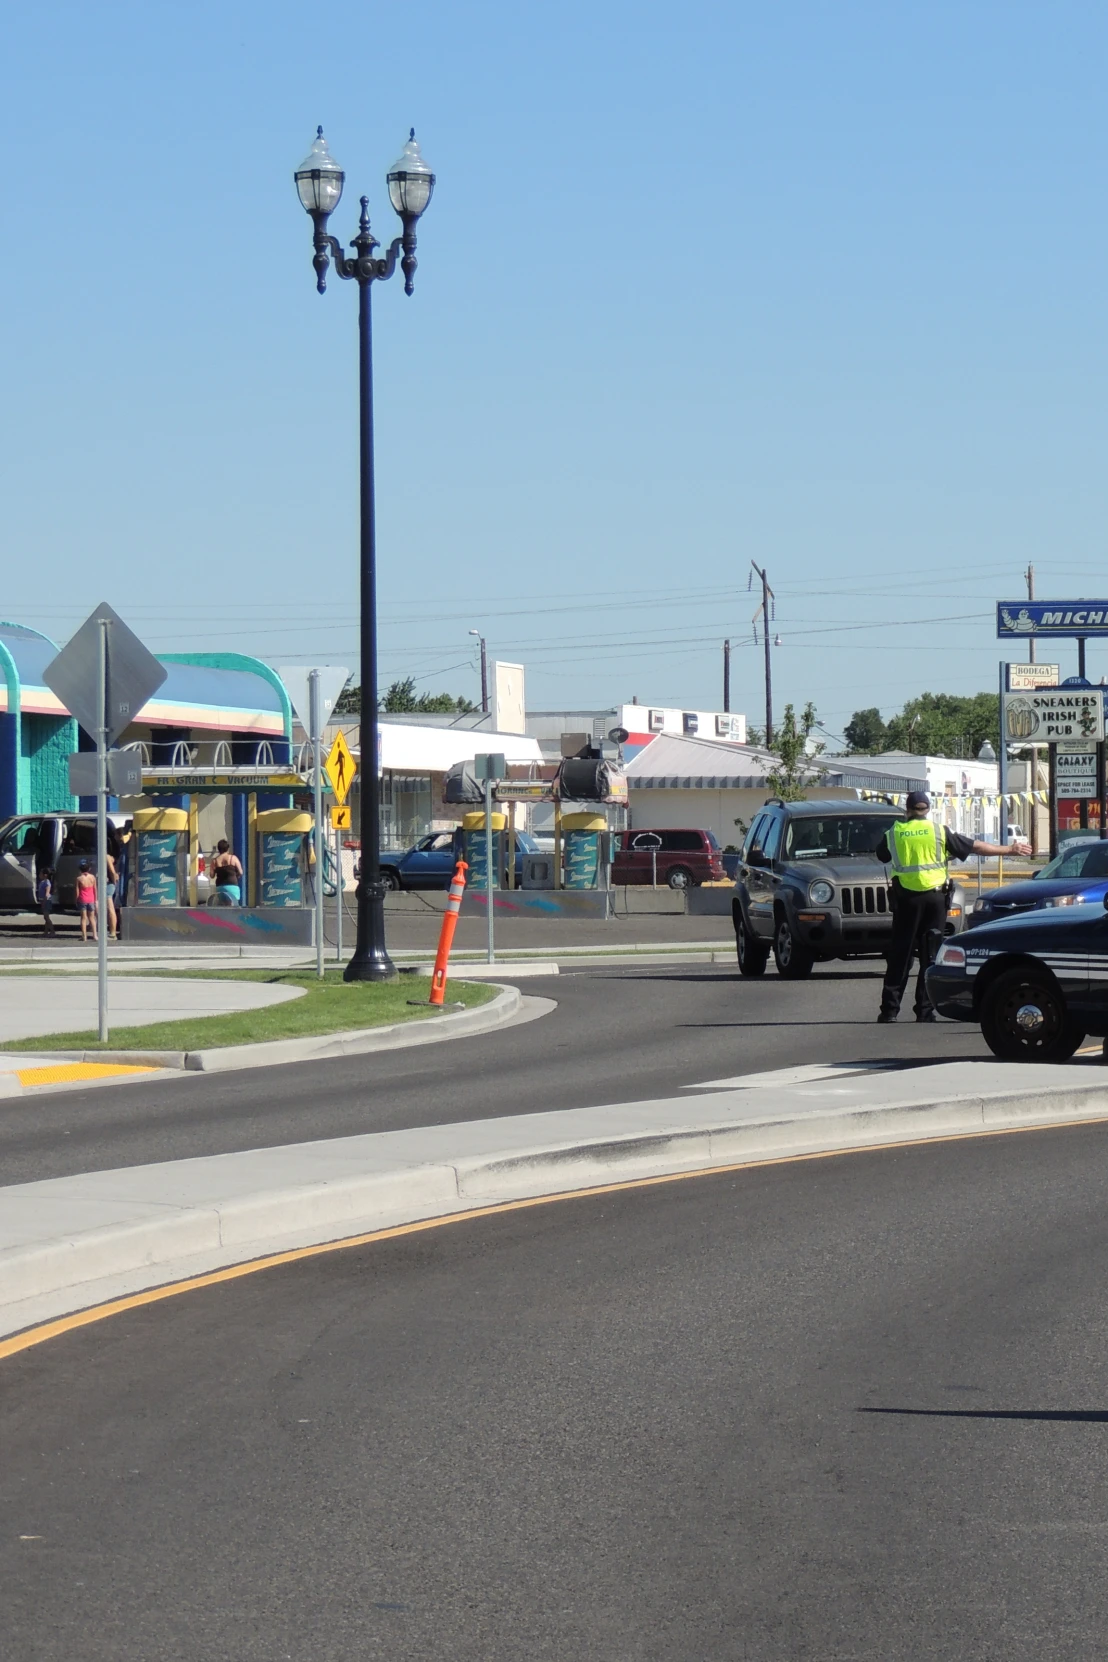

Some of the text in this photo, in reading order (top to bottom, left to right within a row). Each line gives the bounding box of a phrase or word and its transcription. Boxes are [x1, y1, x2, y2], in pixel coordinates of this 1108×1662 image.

[1017, 667, 1049, 675] BODEGA
[1011, 678, 1020, 687] La
[1033, 696, 1097, 708] SNEAKERS
[1042, 711, 1076, 722] IRISH
[1047, 725, 1073, 736] PUB
[1057, 756, 1094, 767] GALAXY
[227, 775, 269, 785] VACUUM
[899, 829, 929, 839] POLICE
[971, 948, 989, 956] 07-124
